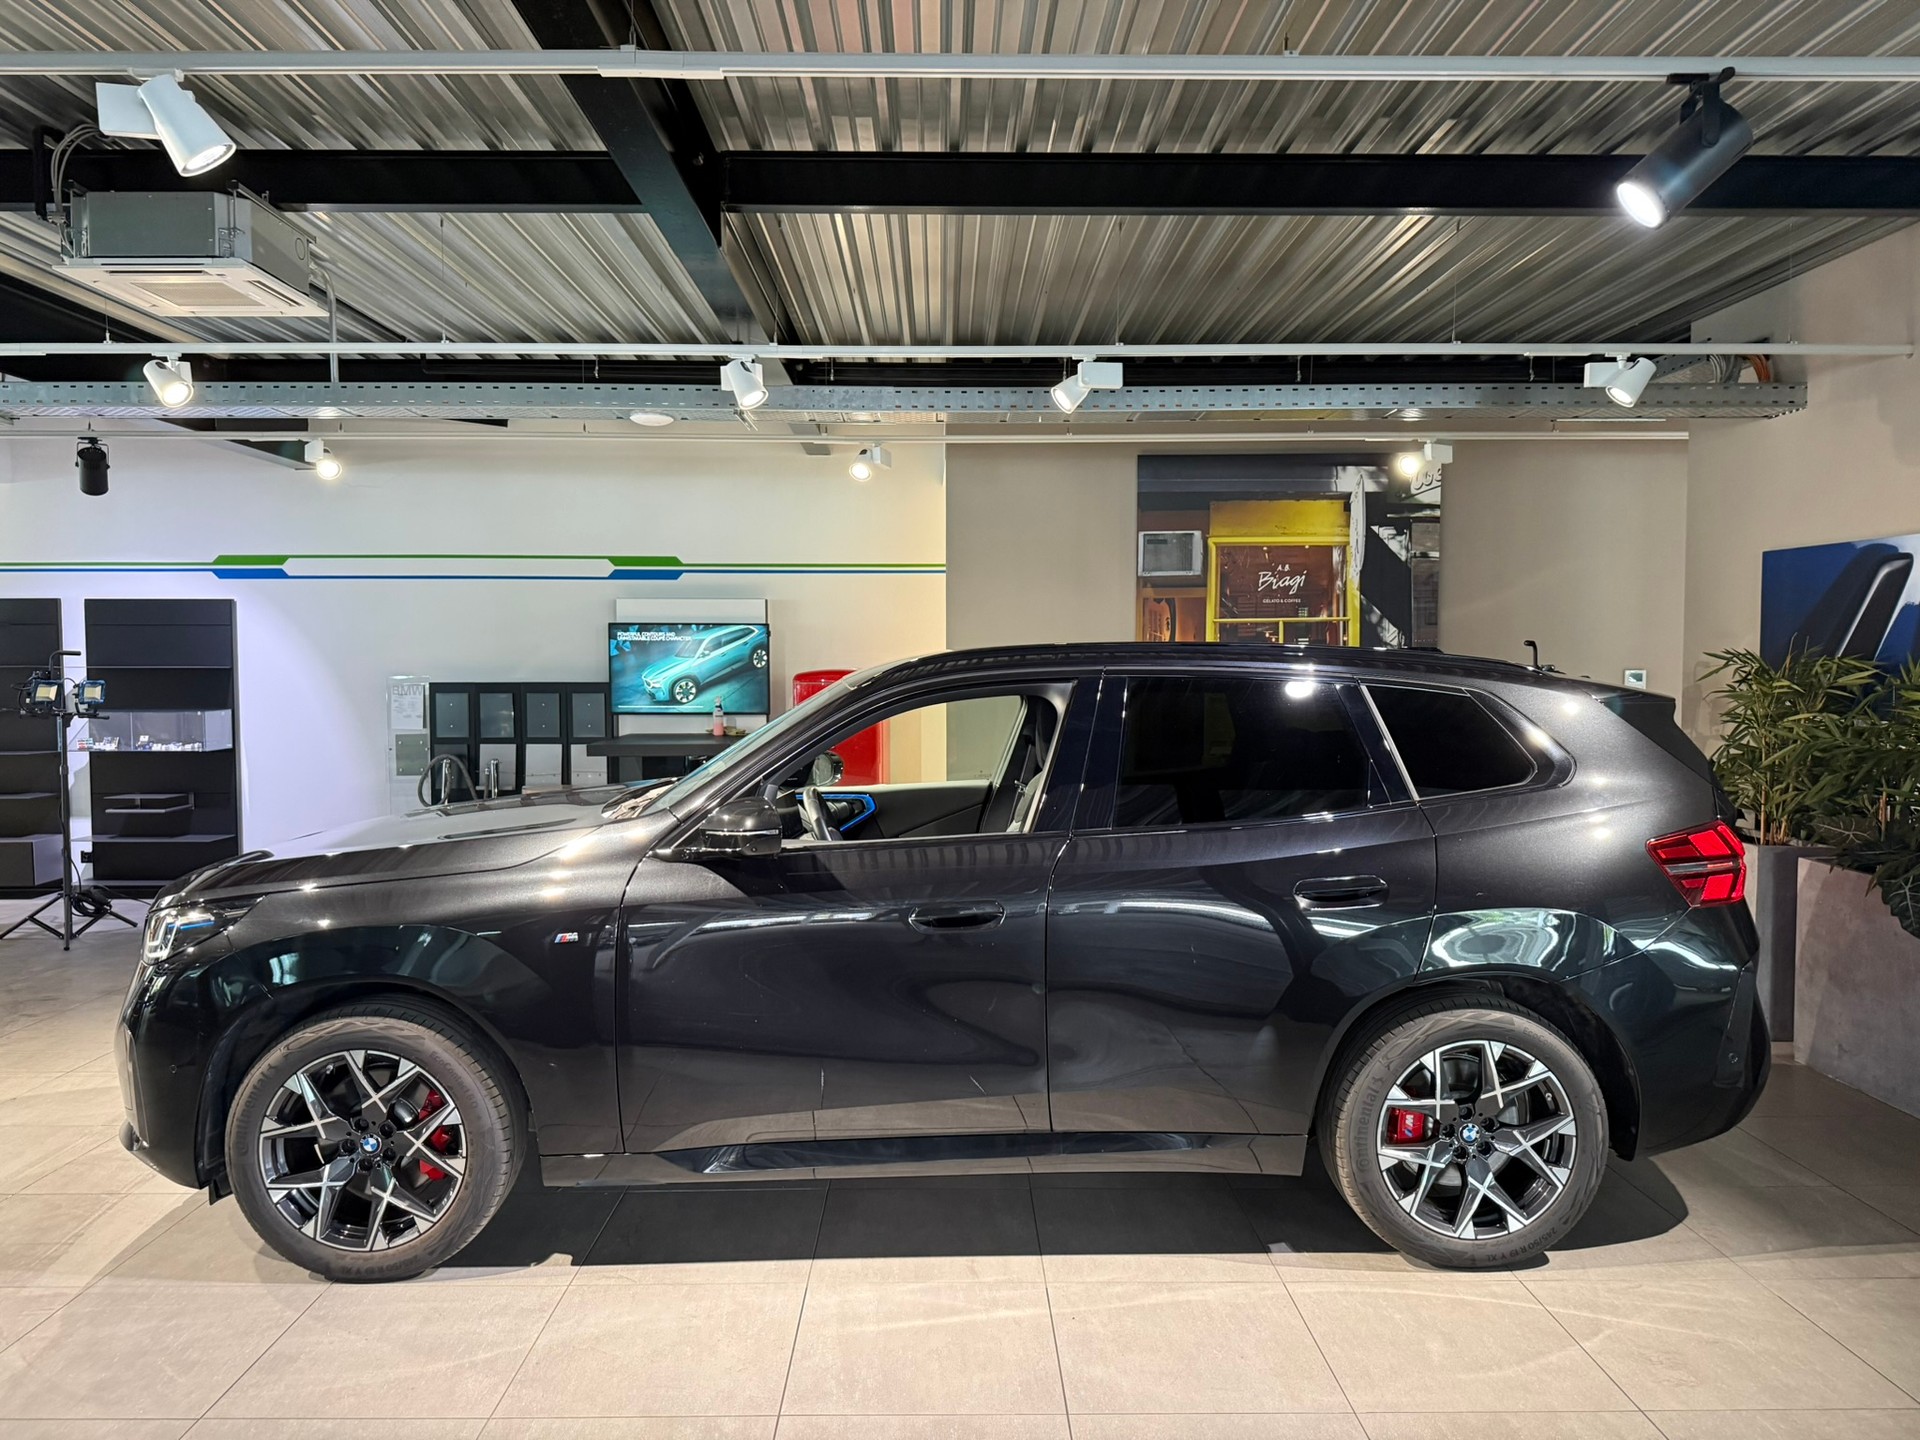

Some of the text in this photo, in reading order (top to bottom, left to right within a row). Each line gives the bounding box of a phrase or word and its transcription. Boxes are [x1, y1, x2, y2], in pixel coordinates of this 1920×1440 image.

[1258, 570, 1308, 594] Biagi
[392, 686, 422, 696] BMW
[1354, 1085, 1379, 1173] Continental
[1528, 1227, 1558, 1250] 245/50
[1510, 1249, 1519, 1258] 19
[1520, 1245, 1527, 1254] R
[1486, 1254, 1497, 1262] XL
